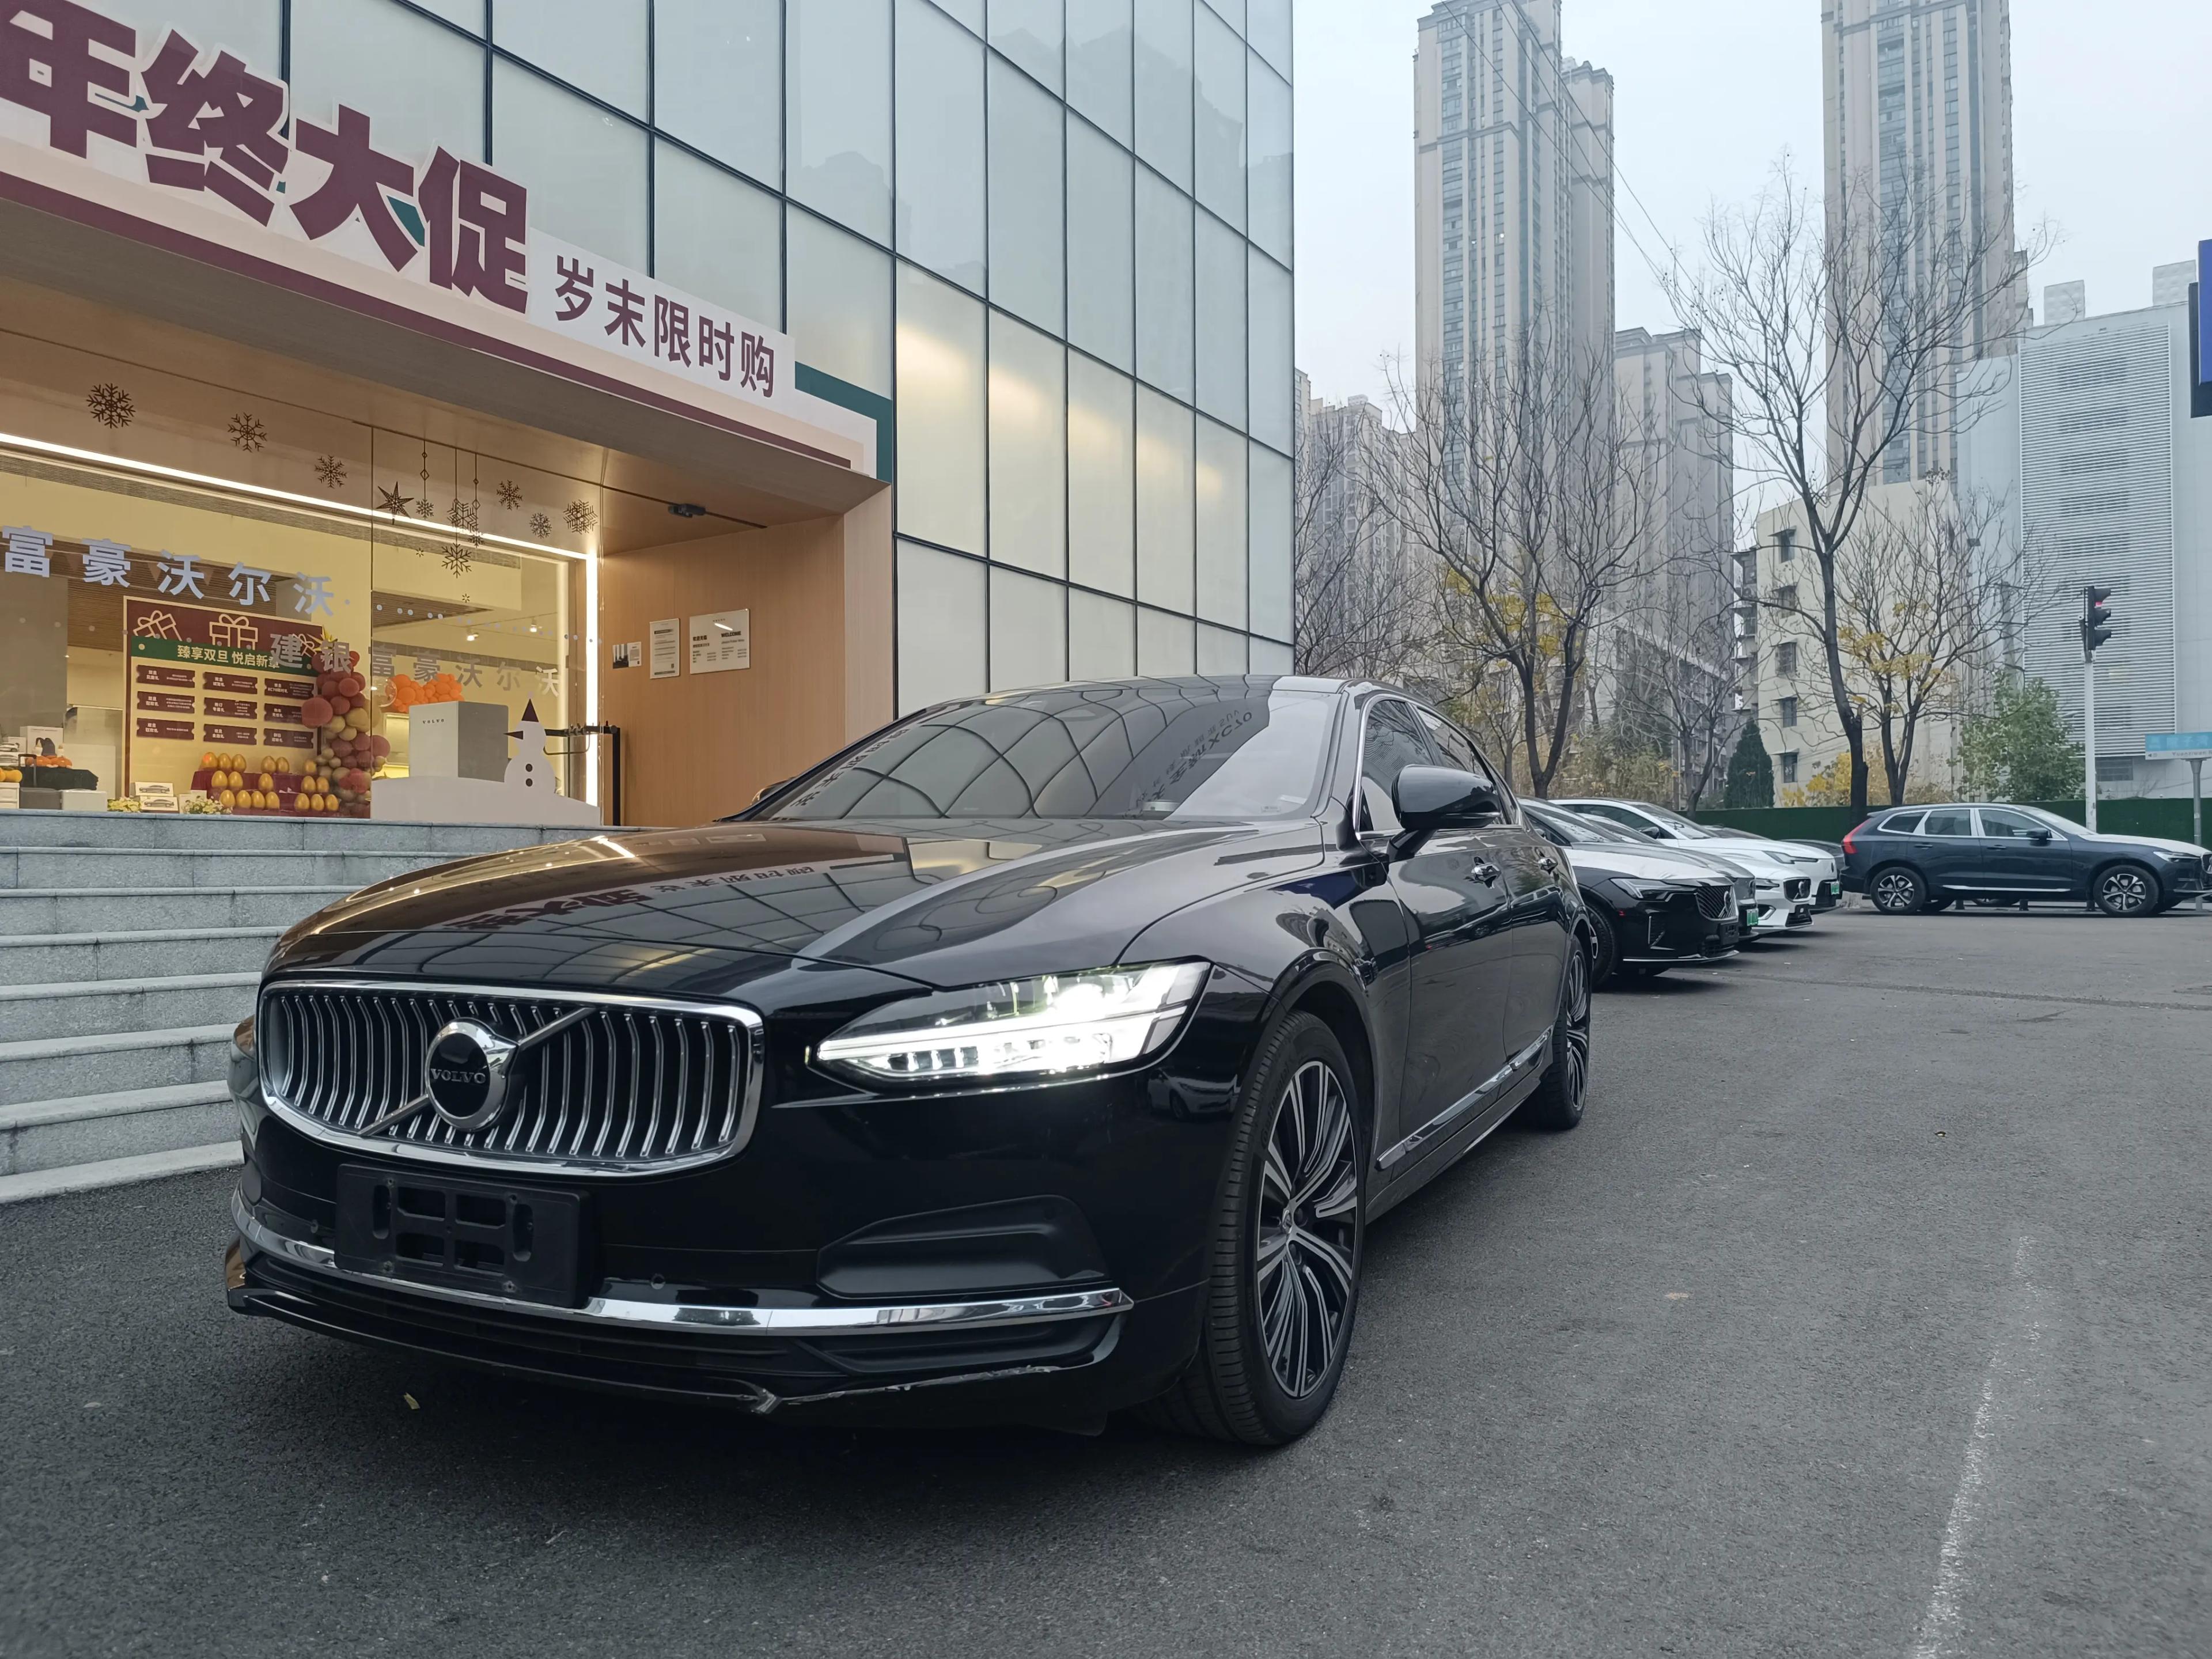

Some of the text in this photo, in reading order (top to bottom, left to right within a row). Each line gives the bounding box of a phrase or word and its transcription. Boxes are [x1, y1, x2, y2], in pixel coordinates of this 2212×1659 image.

[0, 0, 529, 315] 年终大促
[555, 255, 775, 398] 岁末限时购
[2, 525, 335, 616] 富豪沃尔沃
[177, 645, 229, 663] 臻享双旦
[430, 1068, 486, 1084] VOLVO
